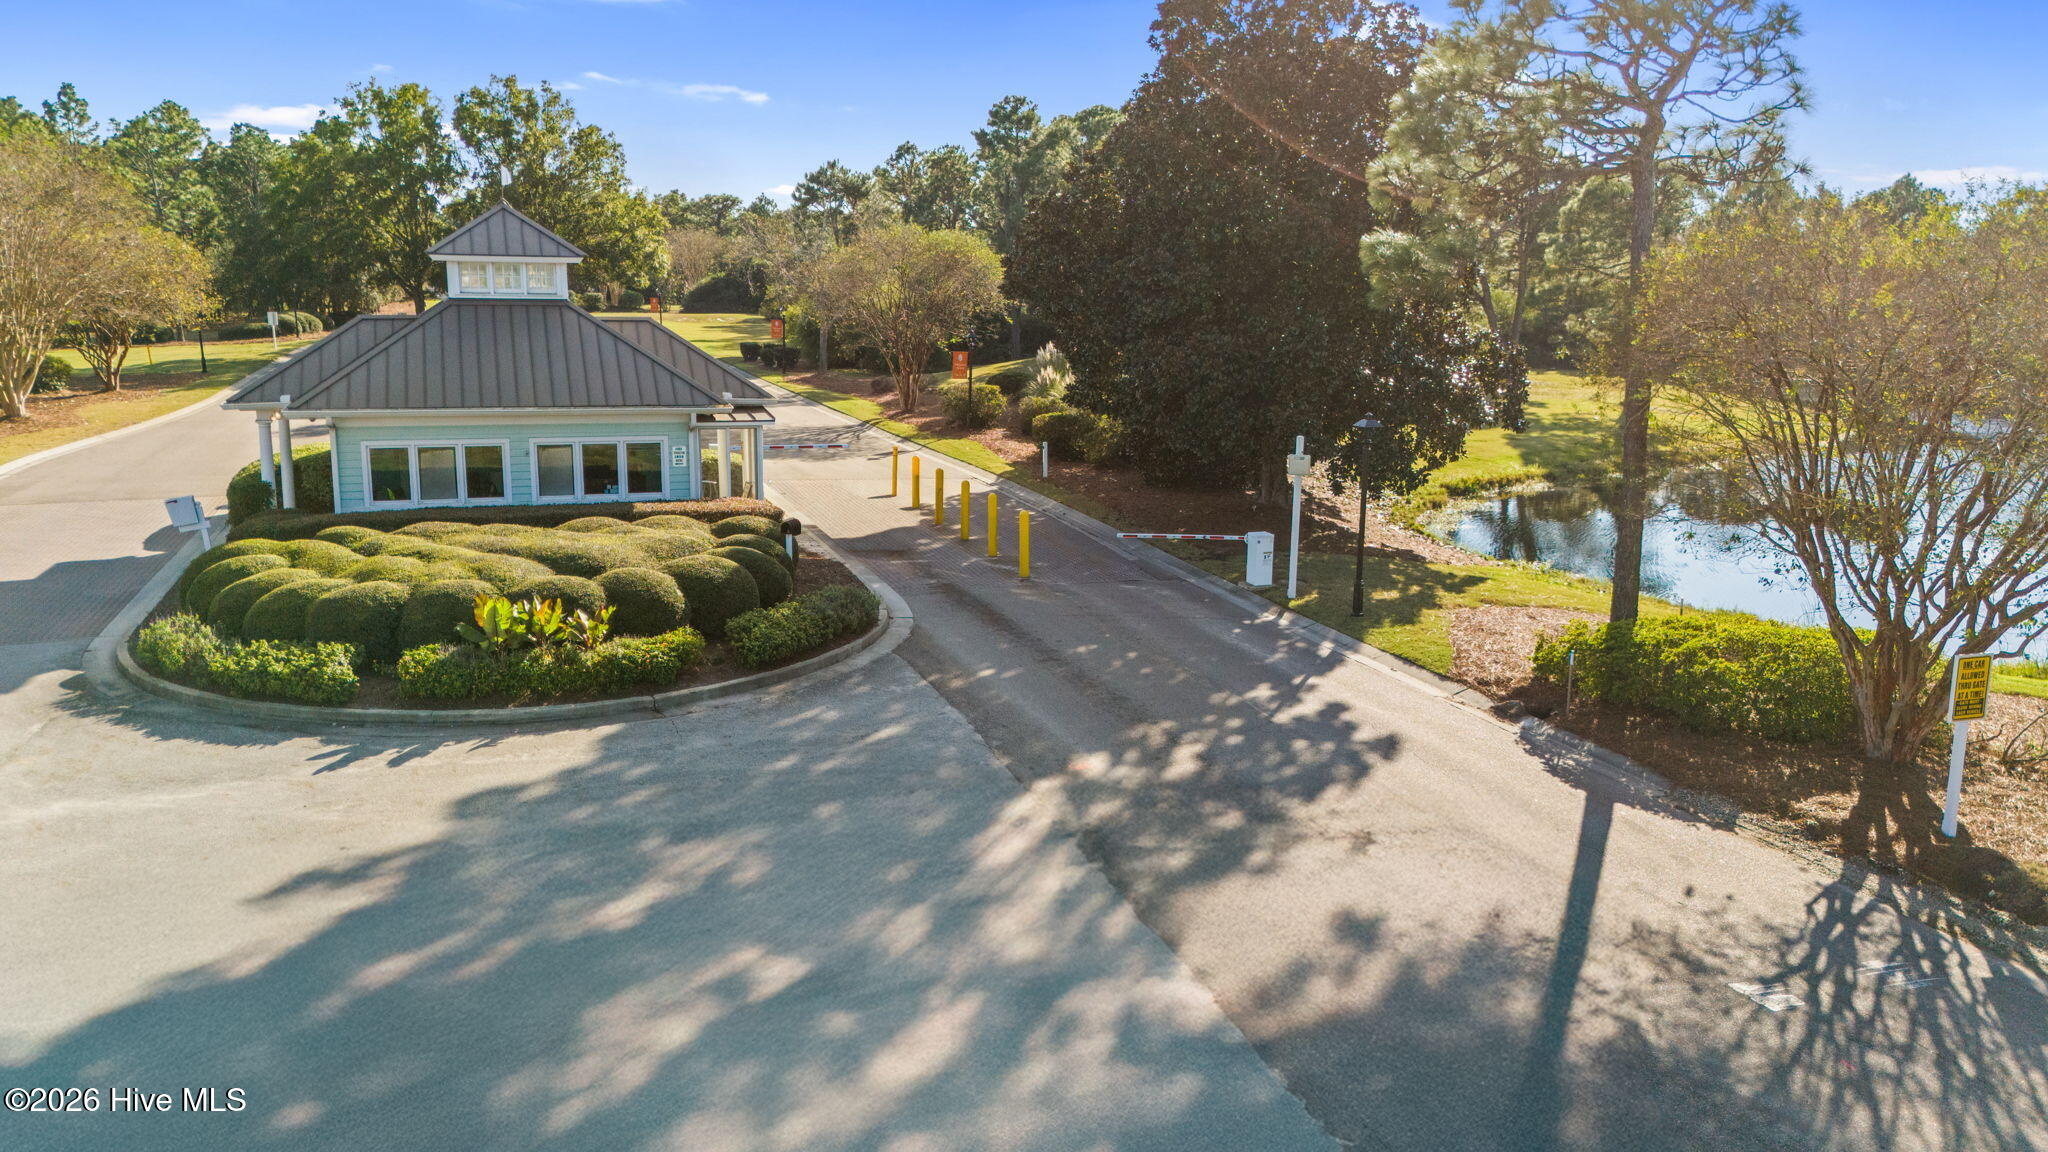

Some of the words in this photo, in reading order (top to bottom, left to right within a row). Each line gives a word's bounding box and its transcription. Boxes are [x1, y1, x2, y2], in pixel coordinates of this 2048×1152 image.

[1975, 660, 1985, 668] CAR
[1961, 671, 1985, 680] ALLOWED
[1958, 682, 1971, 690] THRU
